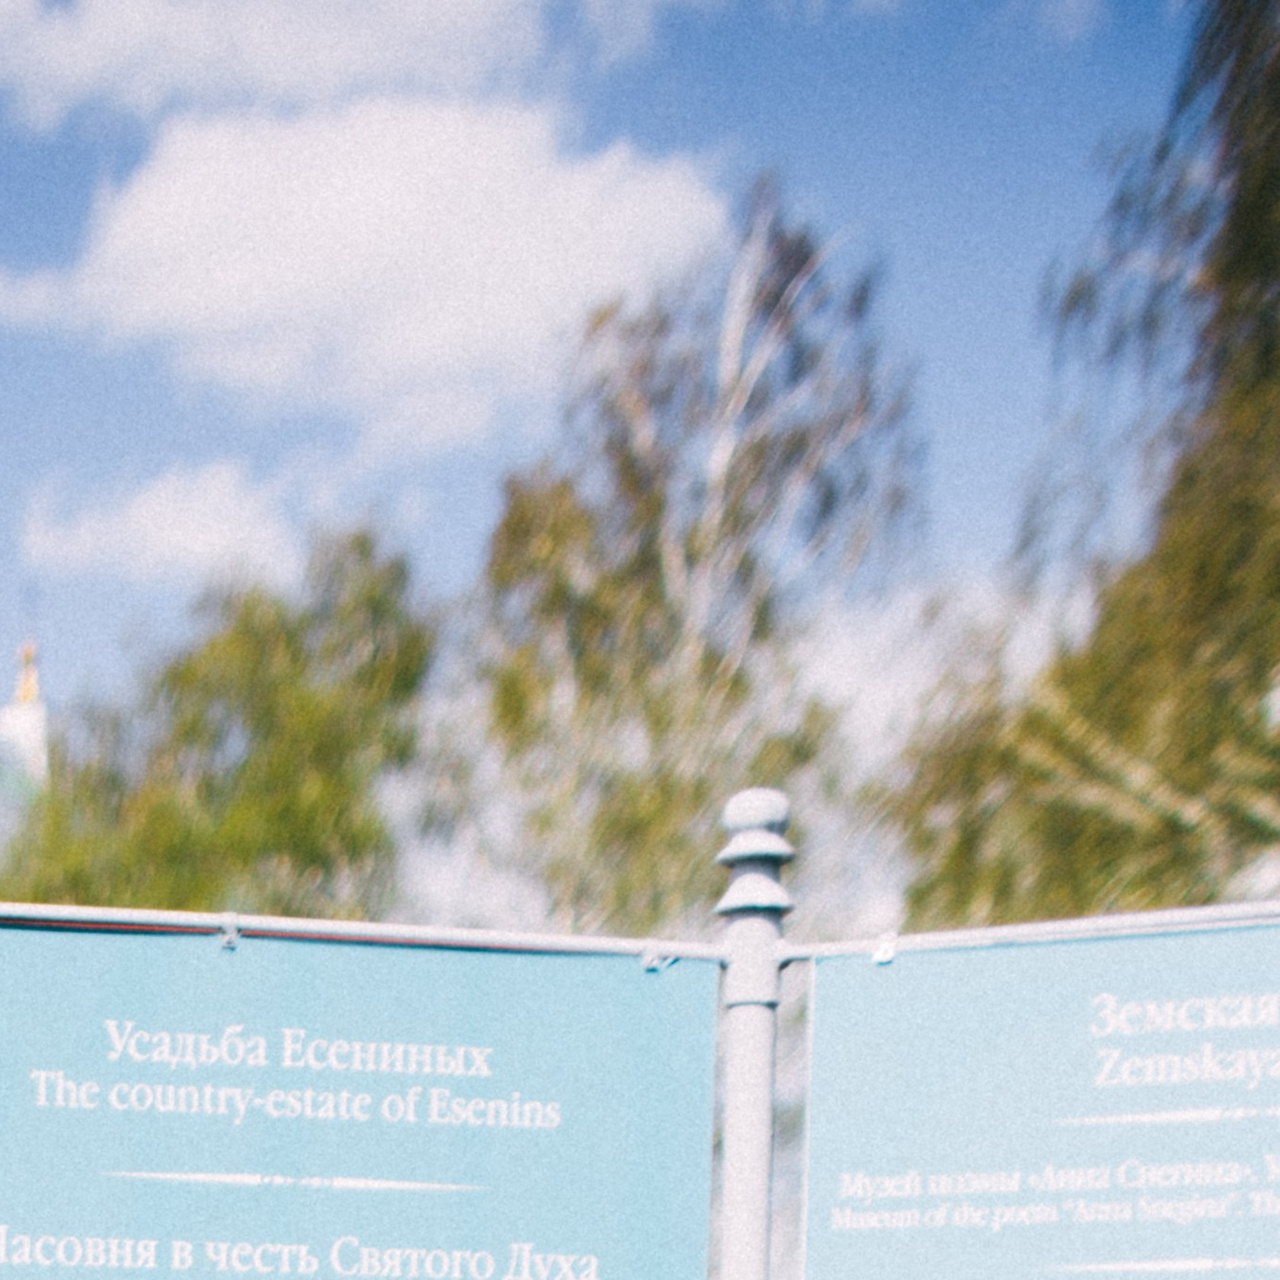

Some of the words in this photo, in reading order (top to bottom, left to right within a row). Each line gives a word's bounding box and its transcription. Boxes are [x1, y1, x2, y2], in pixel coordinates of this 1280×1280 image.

[104, 1019, 268, 1070] Усадьба
[281, 1027, 493, 1078] Есениных
[29, 1069, 101, 1109] The
[108, 1082, 372, 1126] country-estate
[380, 1085, 423, 1123] of
[428, 1087, 562, 1129] Esenins
[922, 1202, 951, 1227] of
[951, 1201, 990, 1227] the
[171, 1240, 194, 1270] в
[205, 1241, 319, 1274] честь
[329, 1235, 496, 1280] Святого
